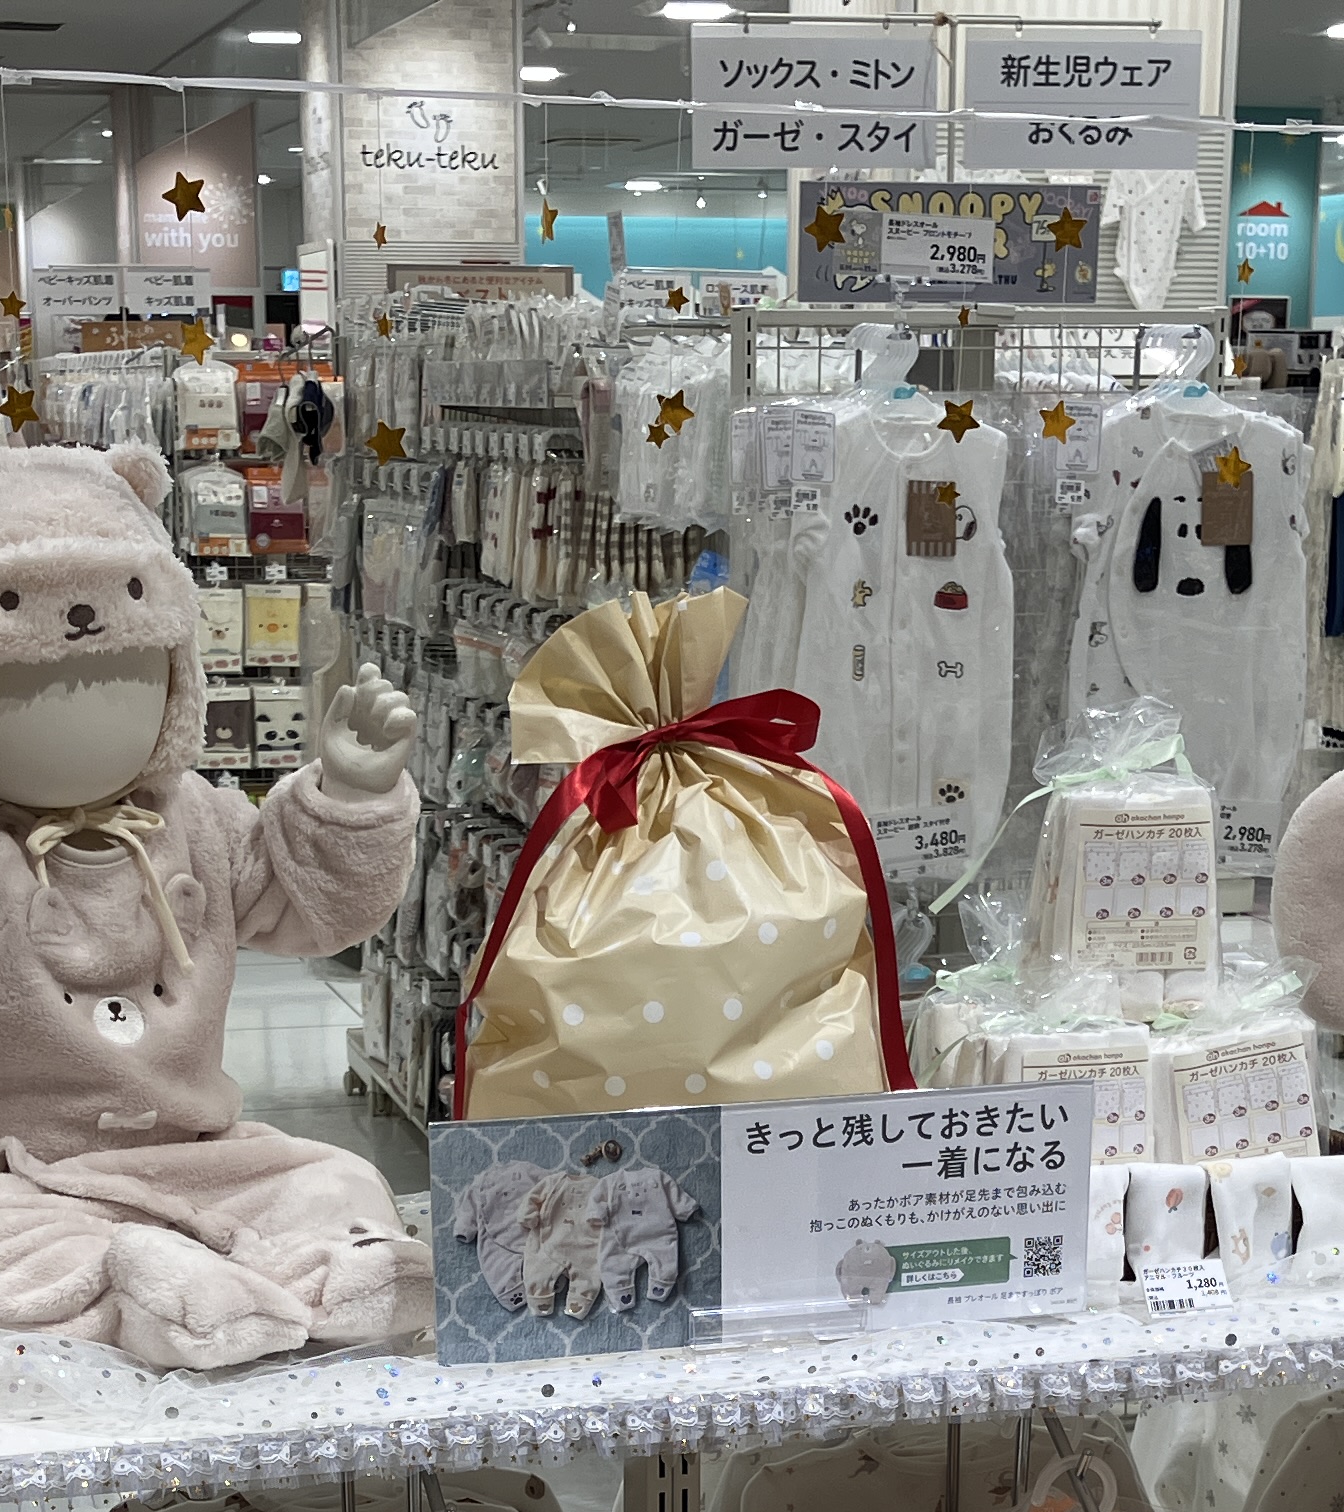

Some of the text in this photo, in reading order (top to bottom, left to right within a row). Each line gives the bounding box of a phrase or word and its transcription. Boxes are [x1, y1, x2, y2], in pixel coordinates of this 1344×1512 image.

[719, 57, 915, 90] ソックス・ミトン
[1001, 55, 1172, 88] 新生児ウェア
[712, 120, 919, 153] ガーゼ・スタイ
[360, 143, 500, 171] teku-teku
[870, 189, 1044, 225] SNOOPY
[144, 227, 239, 253] with you
[1237, 222, 1289, 238] room
[930, 244, 987, 264] 2,980円
[1236, 242, 1289, 261] 10+10
[915, 829, 967, 851] 3,480円
[1093, 827, 1202, 840] ガーゼハンカチ 20枚入
[1224, 825, 1272, 843] 2,980円
[1038, 1065, 1140, 1081] ガーゼハンカチ 20枚入
[1189, 1051, 1297, 1083] ガーゼハンカチ 20枚入
[745, 1102, 1070, 1155] きっと残しておきたい
[902, 1139, 1066, 1180] 一着になる
[847, 1183, 1067, 1212] あったかボア素材が足先まで包み込む
[809, 1200, 1067, 1233] 抱っこのぬくもりも、かけがえのない思い出に
[905, 1271, 958, 1284] 詳しくはこちら
